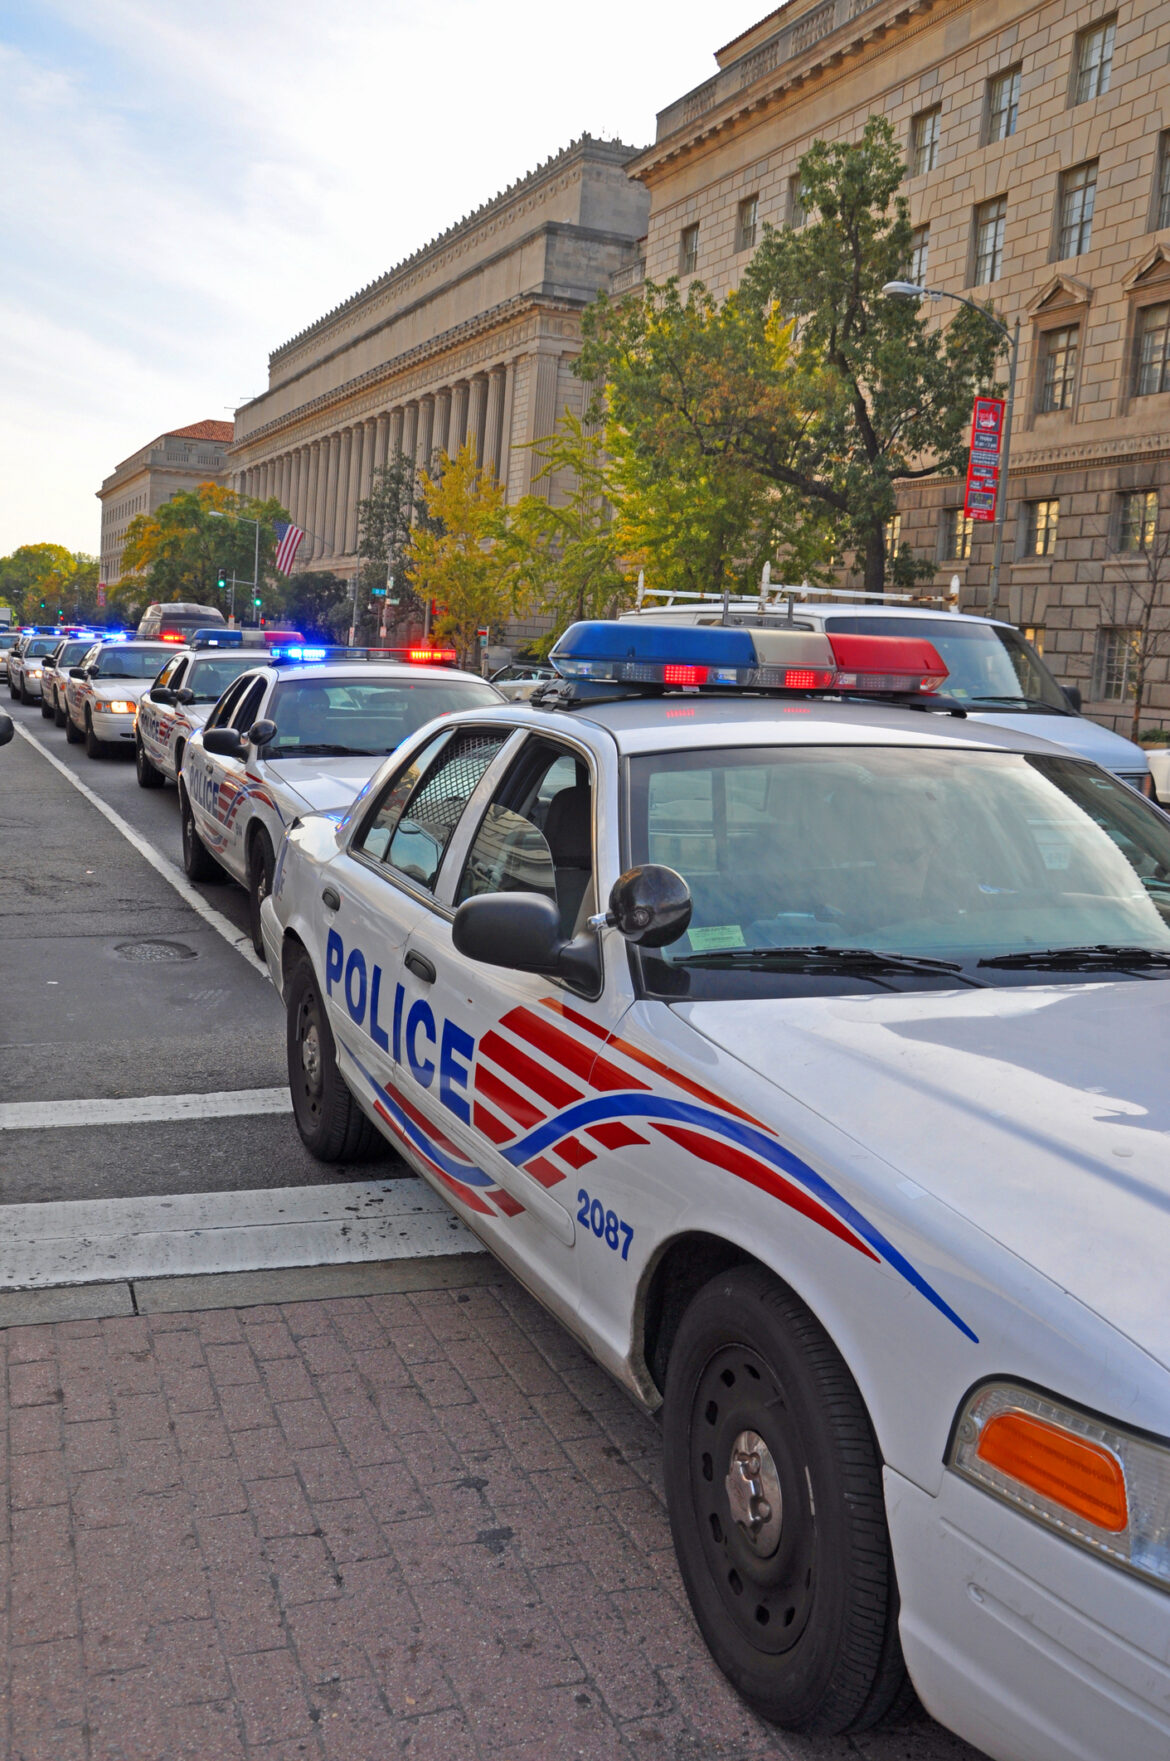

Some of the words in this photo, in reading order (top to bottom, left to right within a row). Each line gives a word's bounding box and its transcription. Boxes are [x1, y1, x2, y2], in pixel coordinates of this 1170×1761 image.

[190, 765, 220, 820] POLICE
[326, 928, 475, 1127] POLICE
[577, 1188, 634, 1262] 2087
